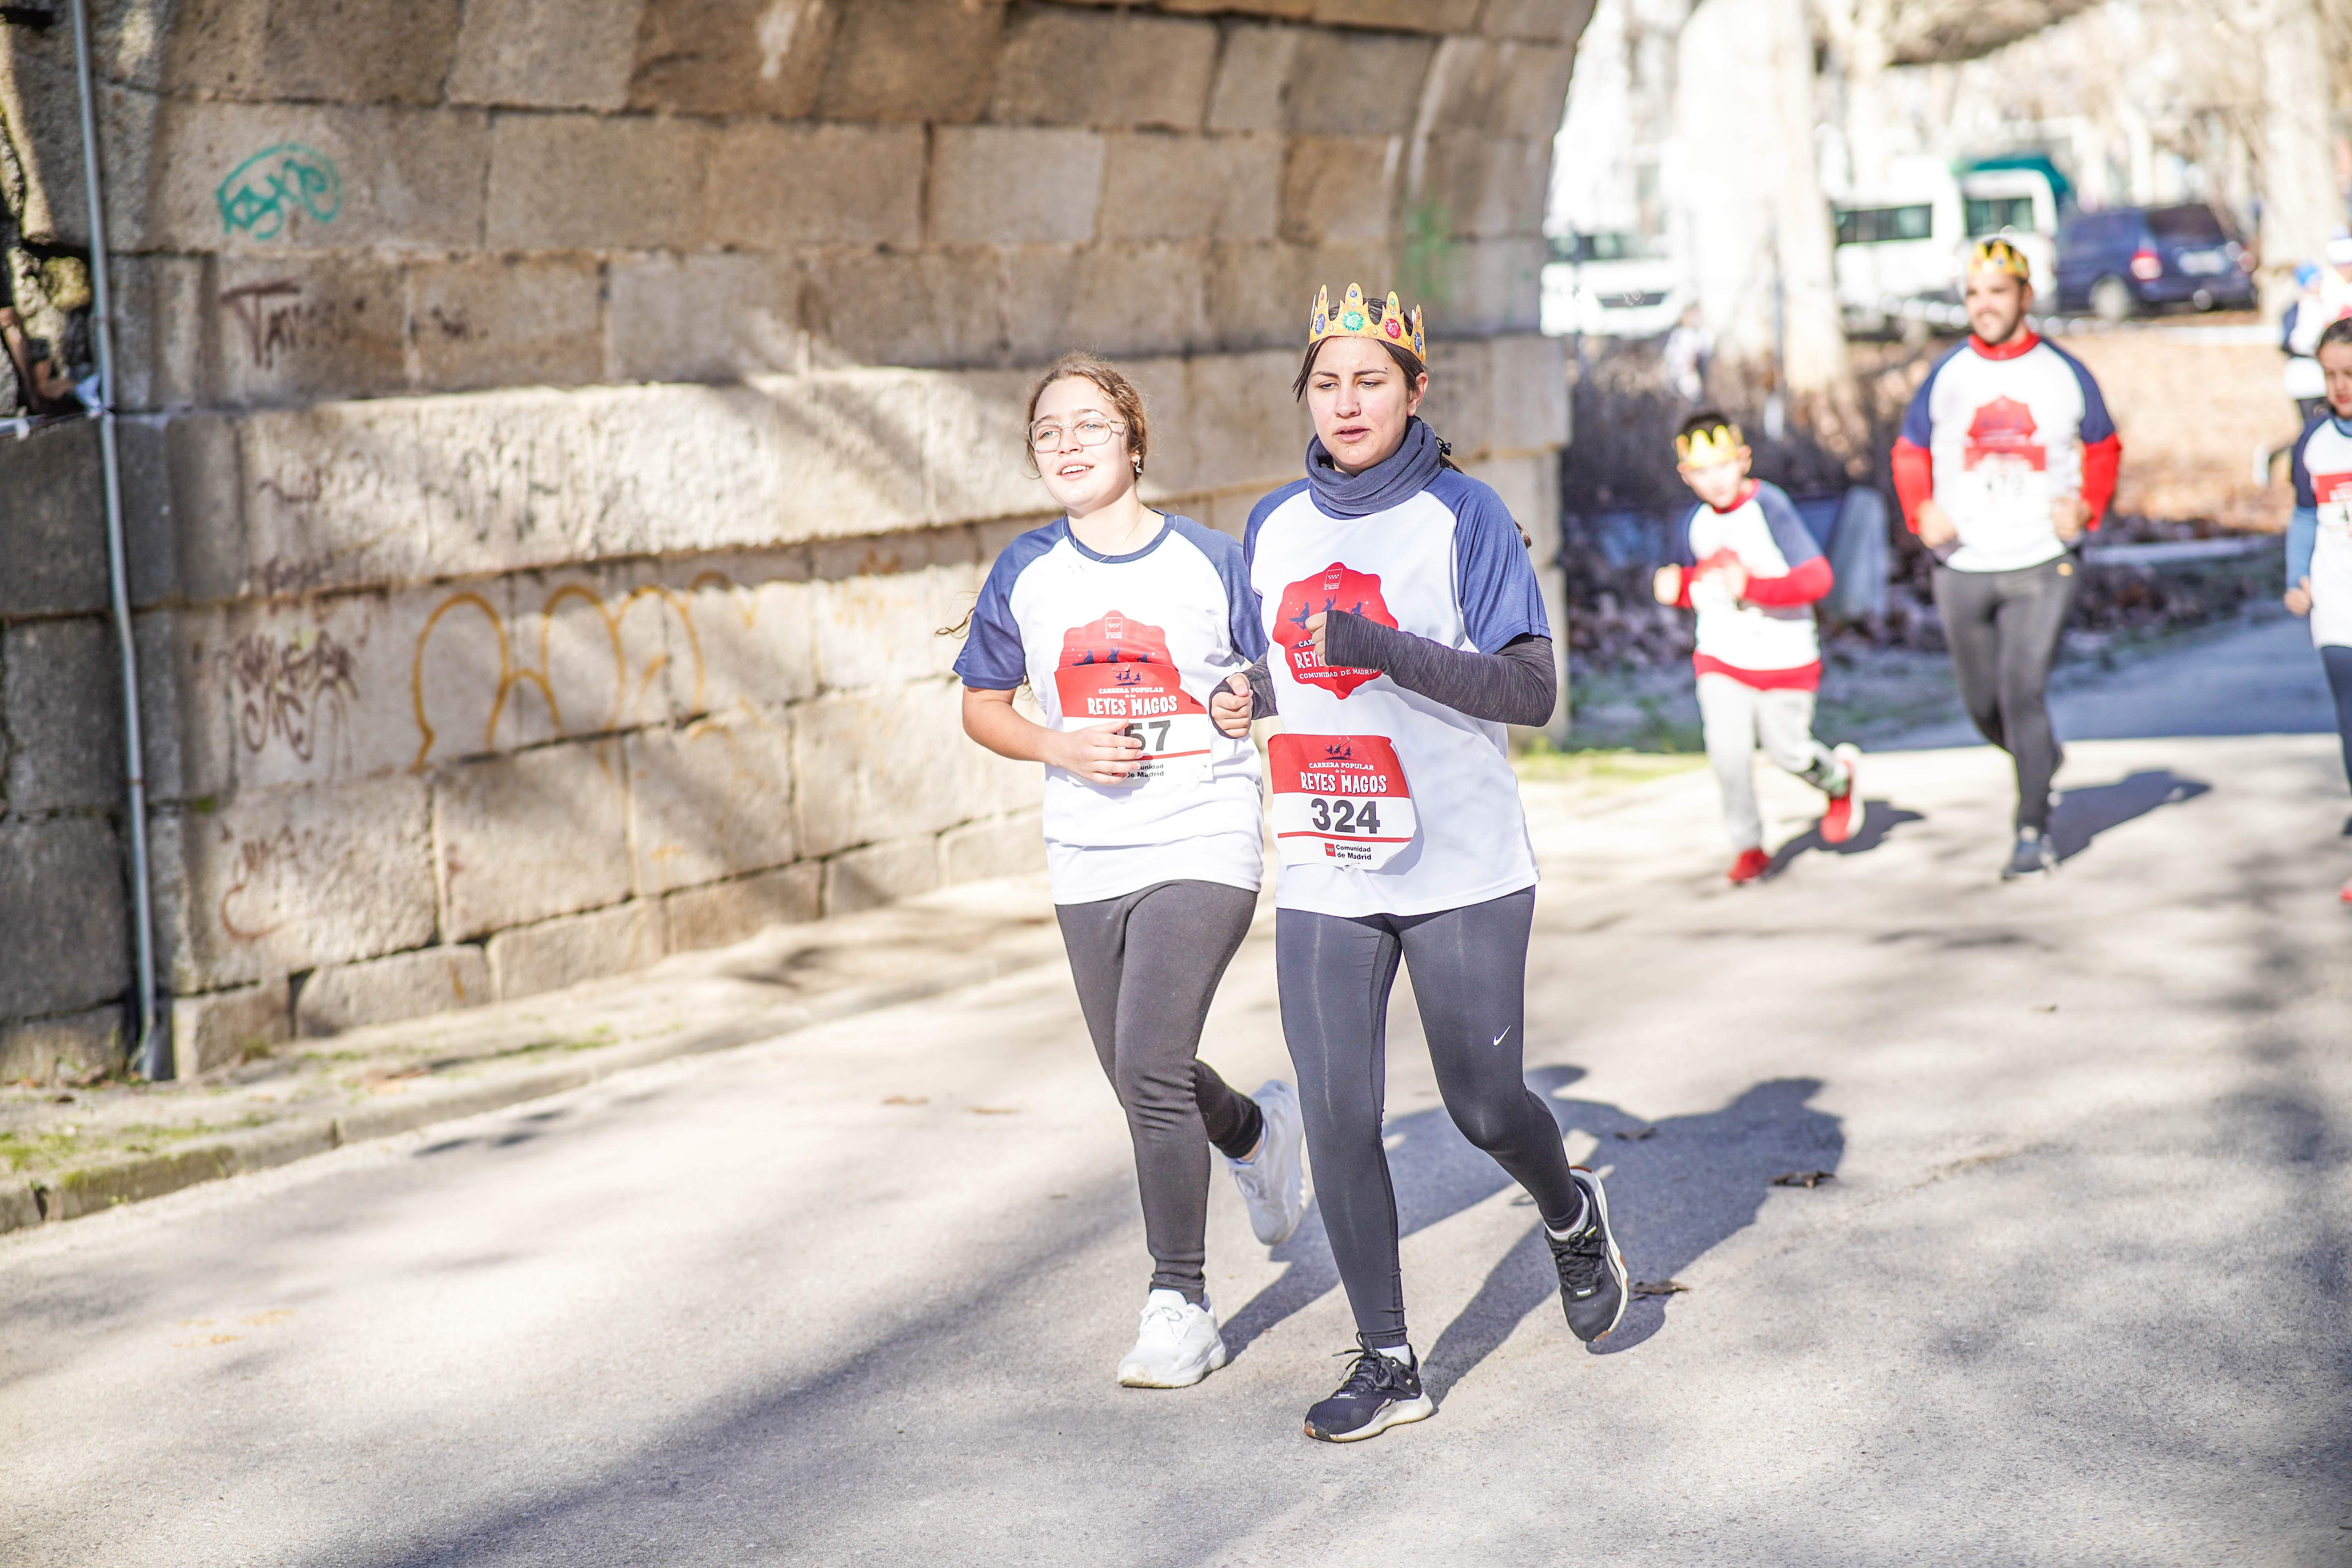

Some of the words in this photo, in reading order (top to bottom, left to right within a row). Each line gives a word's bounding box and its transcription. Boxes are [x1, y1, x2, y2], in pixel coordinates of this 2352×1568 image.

[1293, 650, 1323, 669] REY
[1087, 697, 1127, 716] REYES
[1131, 695, 1178, 716] MAGOS
[1113, 720, 1171, 751] 57
[1299, 771, 1336, 793] REYES
[1341, 774, 1387, 793] MAGOS
[1311, 798, 1380, 834] 324
[1336, 844, 1371, 853] Comunidad
